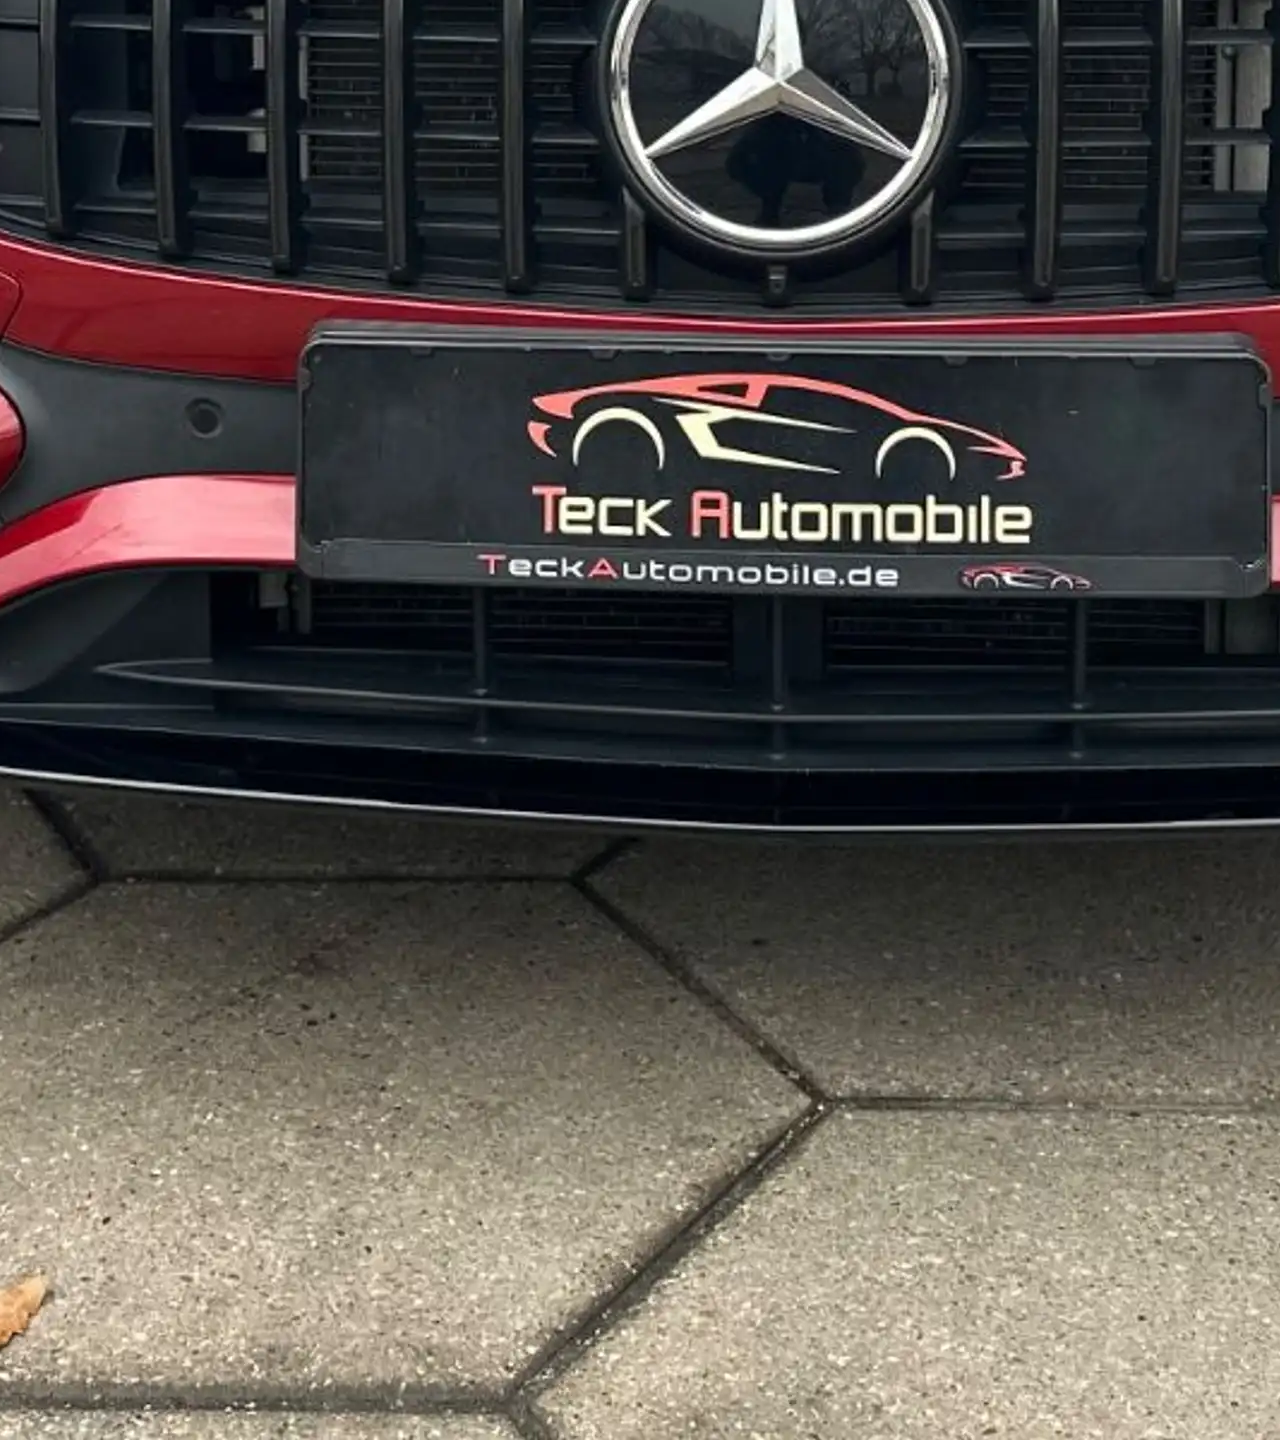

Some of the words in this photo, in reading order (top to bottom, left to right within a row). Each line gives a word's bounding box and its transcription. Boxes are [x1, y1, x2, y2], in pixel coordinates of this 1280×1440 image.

[531, 485, 672, 537] Teck
[691, 489, 1033, 544] Automobile
[476, 554, 899, 587] TeckAutomobile.de
